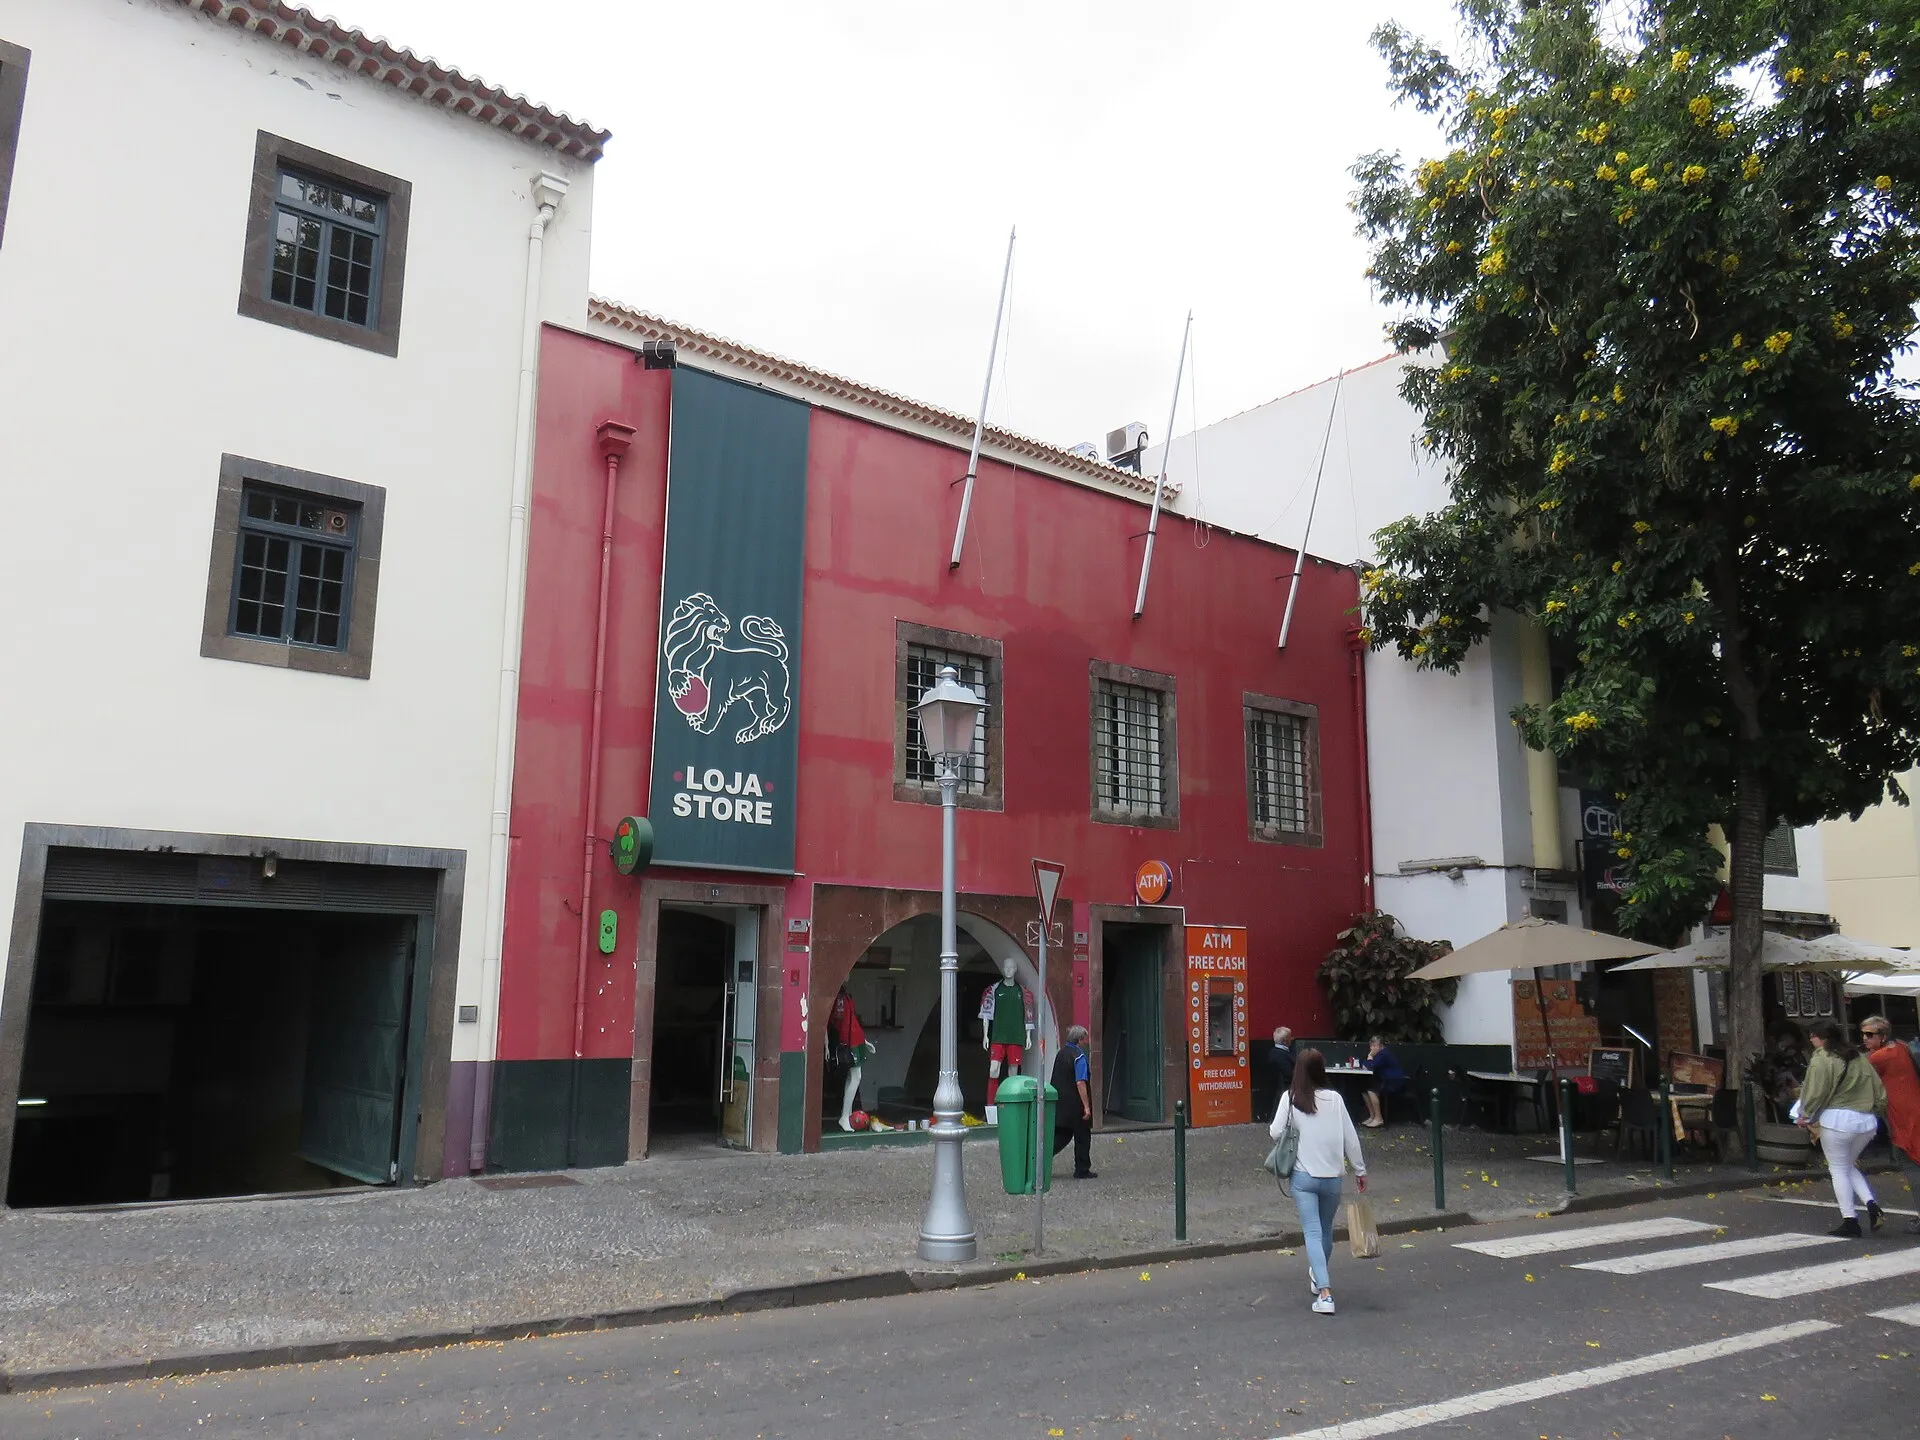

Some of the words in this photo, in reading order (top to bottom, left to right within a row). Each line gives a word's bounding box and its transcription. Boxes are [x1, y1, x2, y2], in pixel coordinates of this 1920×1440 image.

[686, 765, 763, 797] LOJA
[672, 792, 773, 825] STORE
[1138, 873, 1163, 889] ATM
[1203, 933, 1232, 949] ATM
[1188, 955, 1215, 970] FREE
[1216, 956, 1246, 970] CASH
[1203, 1070, 1219, 1079] FREE
[1219, 1069, 1236, 1078] CASH
[1198, 1081, 1243, 1091] WITHDRAWALS
